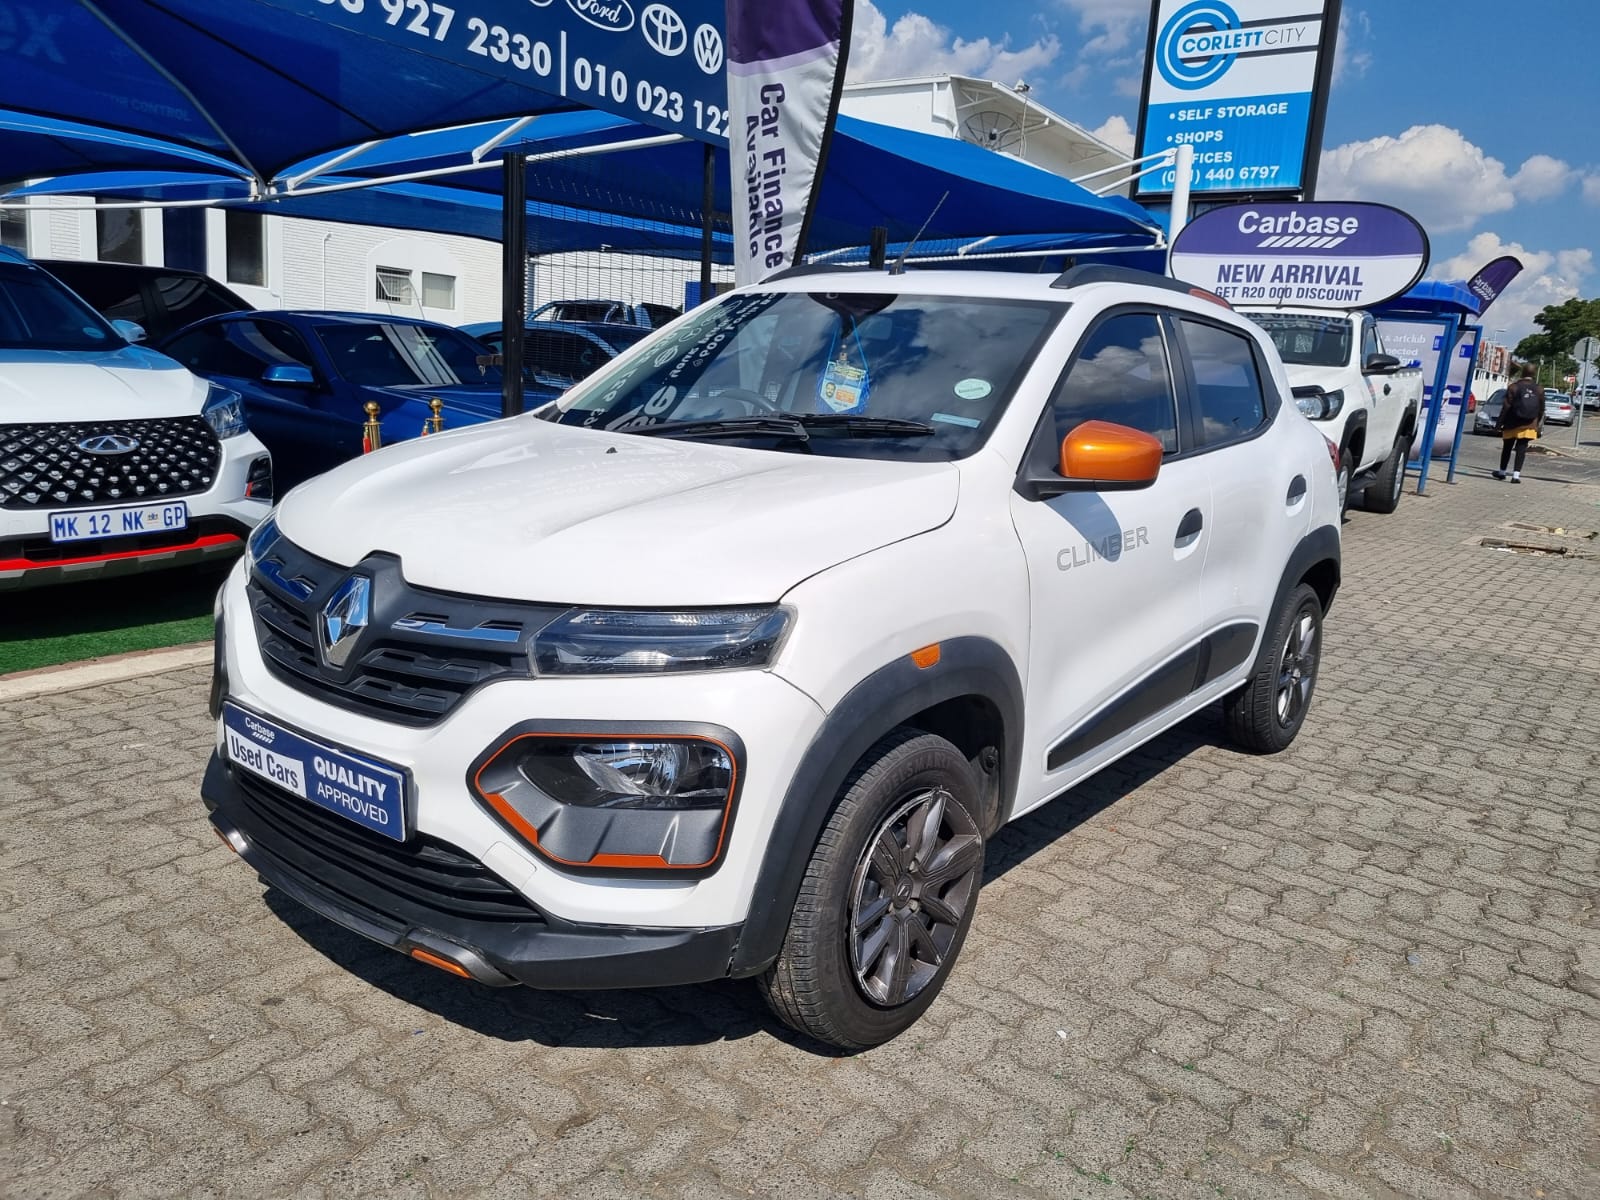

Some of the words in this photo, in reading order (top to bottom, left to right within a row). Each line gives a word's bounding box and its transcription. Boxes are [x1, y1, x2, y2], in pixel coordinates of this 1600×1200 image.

[378, 0, 455, 42] 927
[467, 18, 551, 77] 2330
[574, 58, 628, 103] 010
[636, 81, 684, 123] 023
[693, 100, 729, 138] 122
[760, 83, 786, 138] Car
[1177, 108, 1213, 121] SELF
[1217, 102, 1288, 118] STORAGE
[1175, 130, 1223, 144] SHOPS
[1191, 151, 1233, 164] FICES
[1205, 168, 1235, 181] 440
[1239, 165, 1279, 179] 6797
[763, 148, 786, 269] Finance
[1238, 211, 1359, 235] Carbase
[1217, 264, 1265, 284] NEW
[1270, 264, 1363, 286] ARRIVAL
[1215, 286, 1239, 298] GET
[1241, 286, 1264, 298] R20
[1268, 287, 1292, 299] 000
[1296, 288, 1362, 302] DISCOUNT
[54, 517, 79, 538] MK
[88, 514, 111, 535] 12
[122, 510, 144, 532] NK
[163, 506, 183, 526] GP
[1056, 526, 1150, 571] CLIMBER
[245, 716, 276, 740] Carbase
[231, 735, 263, 770] Used
[266, 754, 299, 789] Cars
[313, 756, 387, 801] QUALITY
[317, 782, 389, 825] APPROVED
